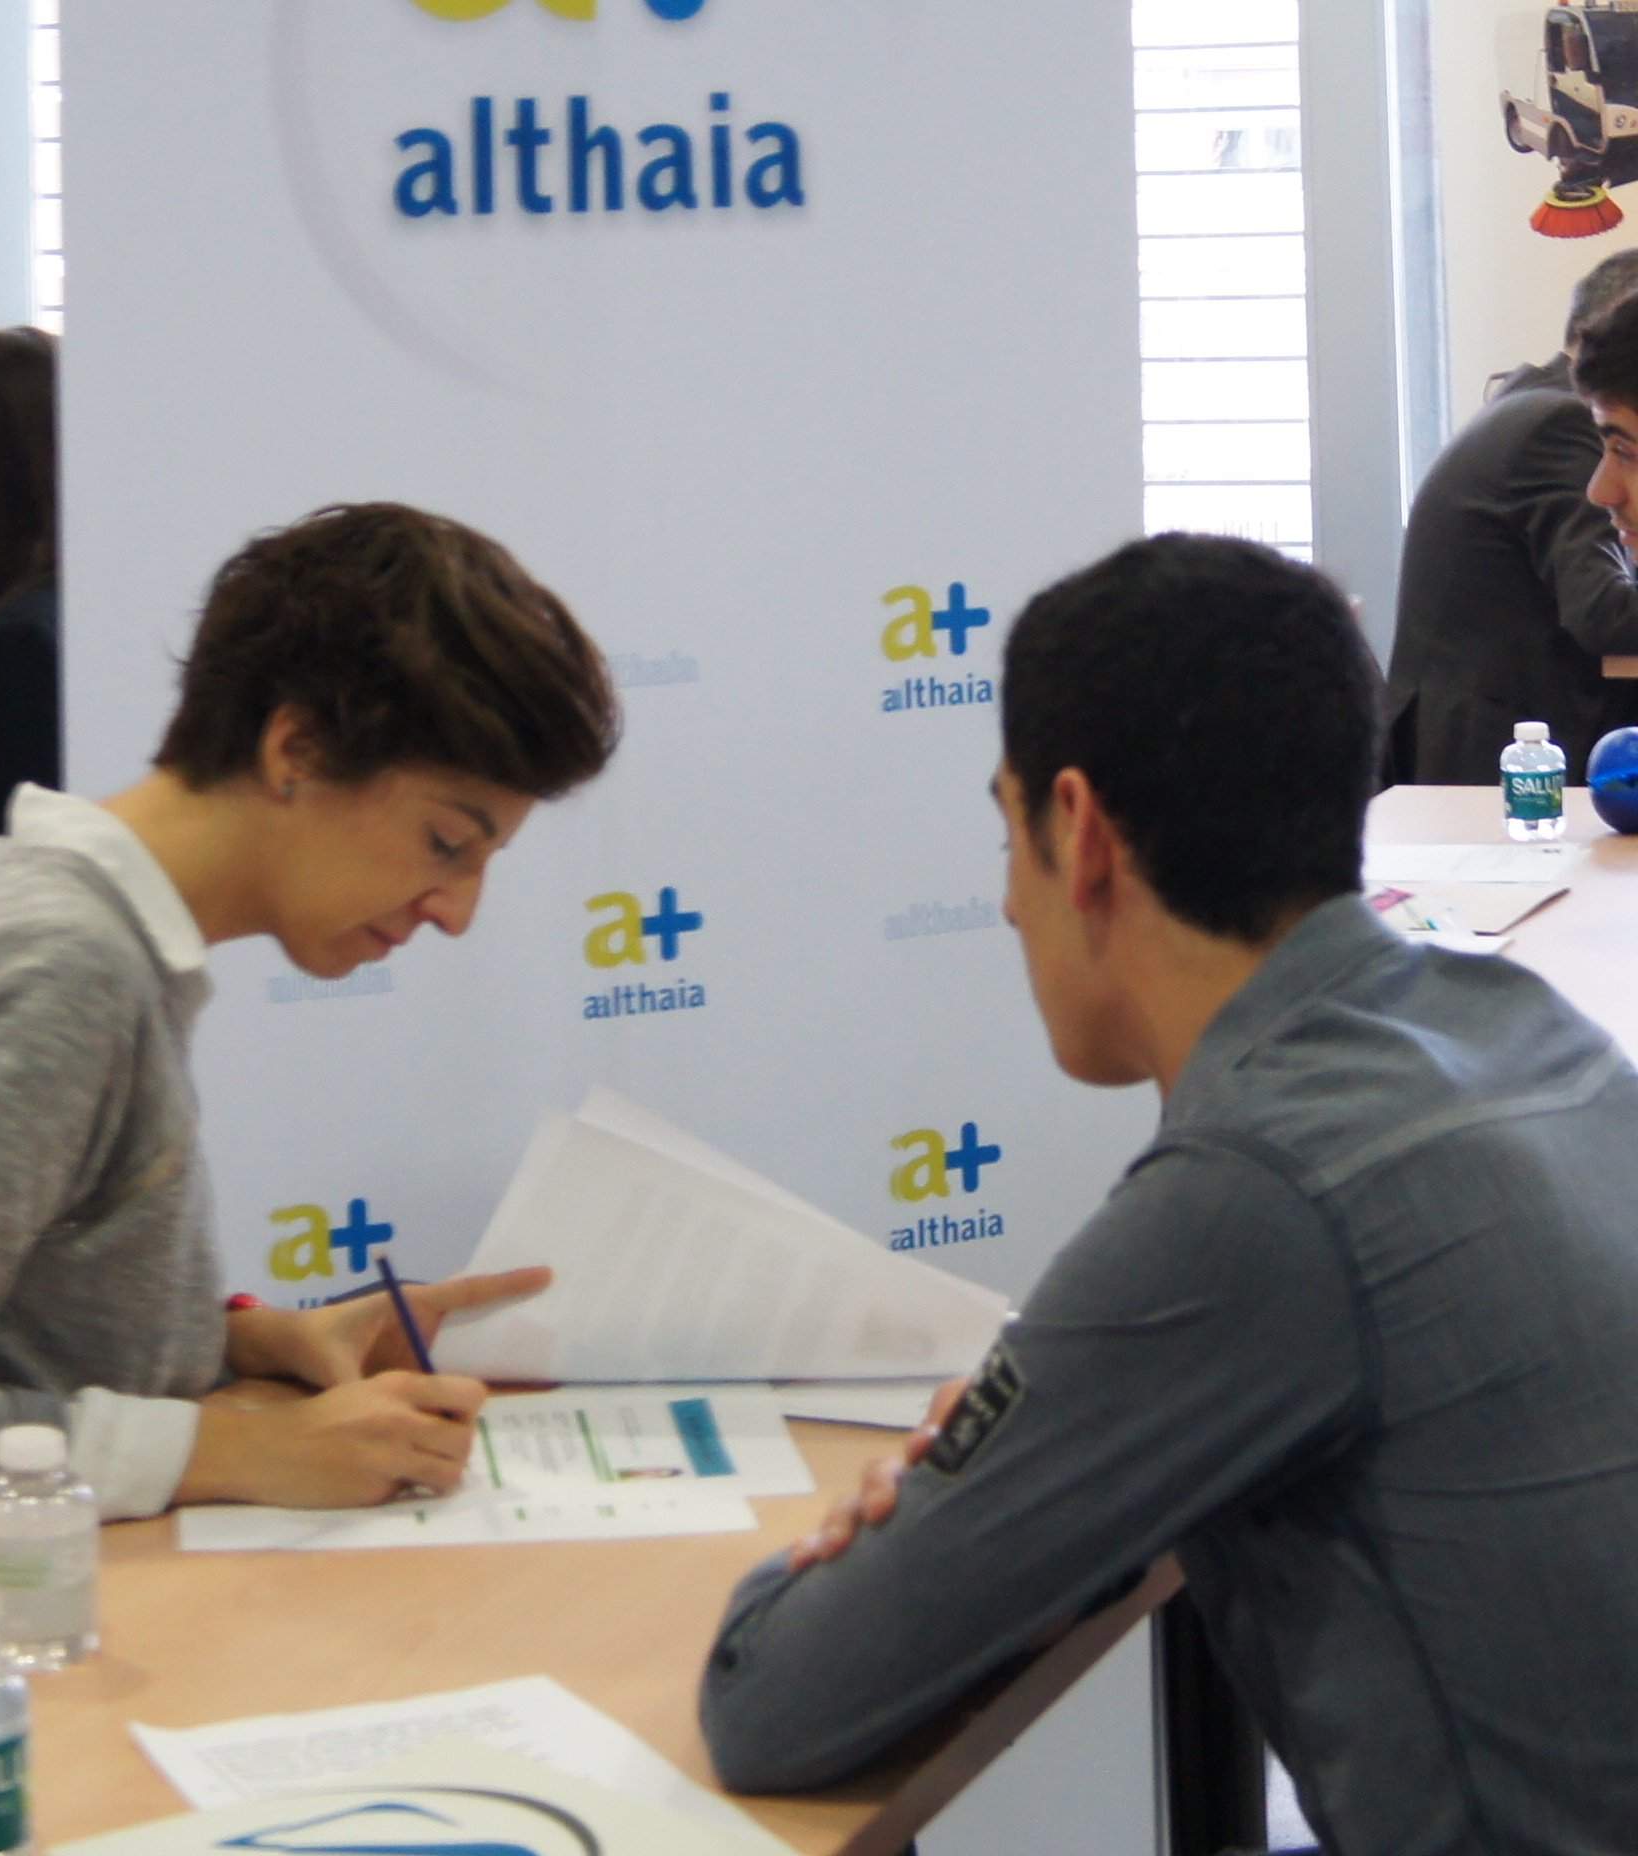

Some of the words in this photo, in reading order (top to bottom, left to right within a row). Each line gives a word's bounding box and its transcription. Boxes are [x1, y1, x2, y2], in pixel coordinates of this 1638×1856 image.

[392, 91, 805, 217] althaia
[881, 672, 995, 714] althaia
[582, 978, 706, 1020] althaia
[889, 1208, 1005, 1252] althaia
